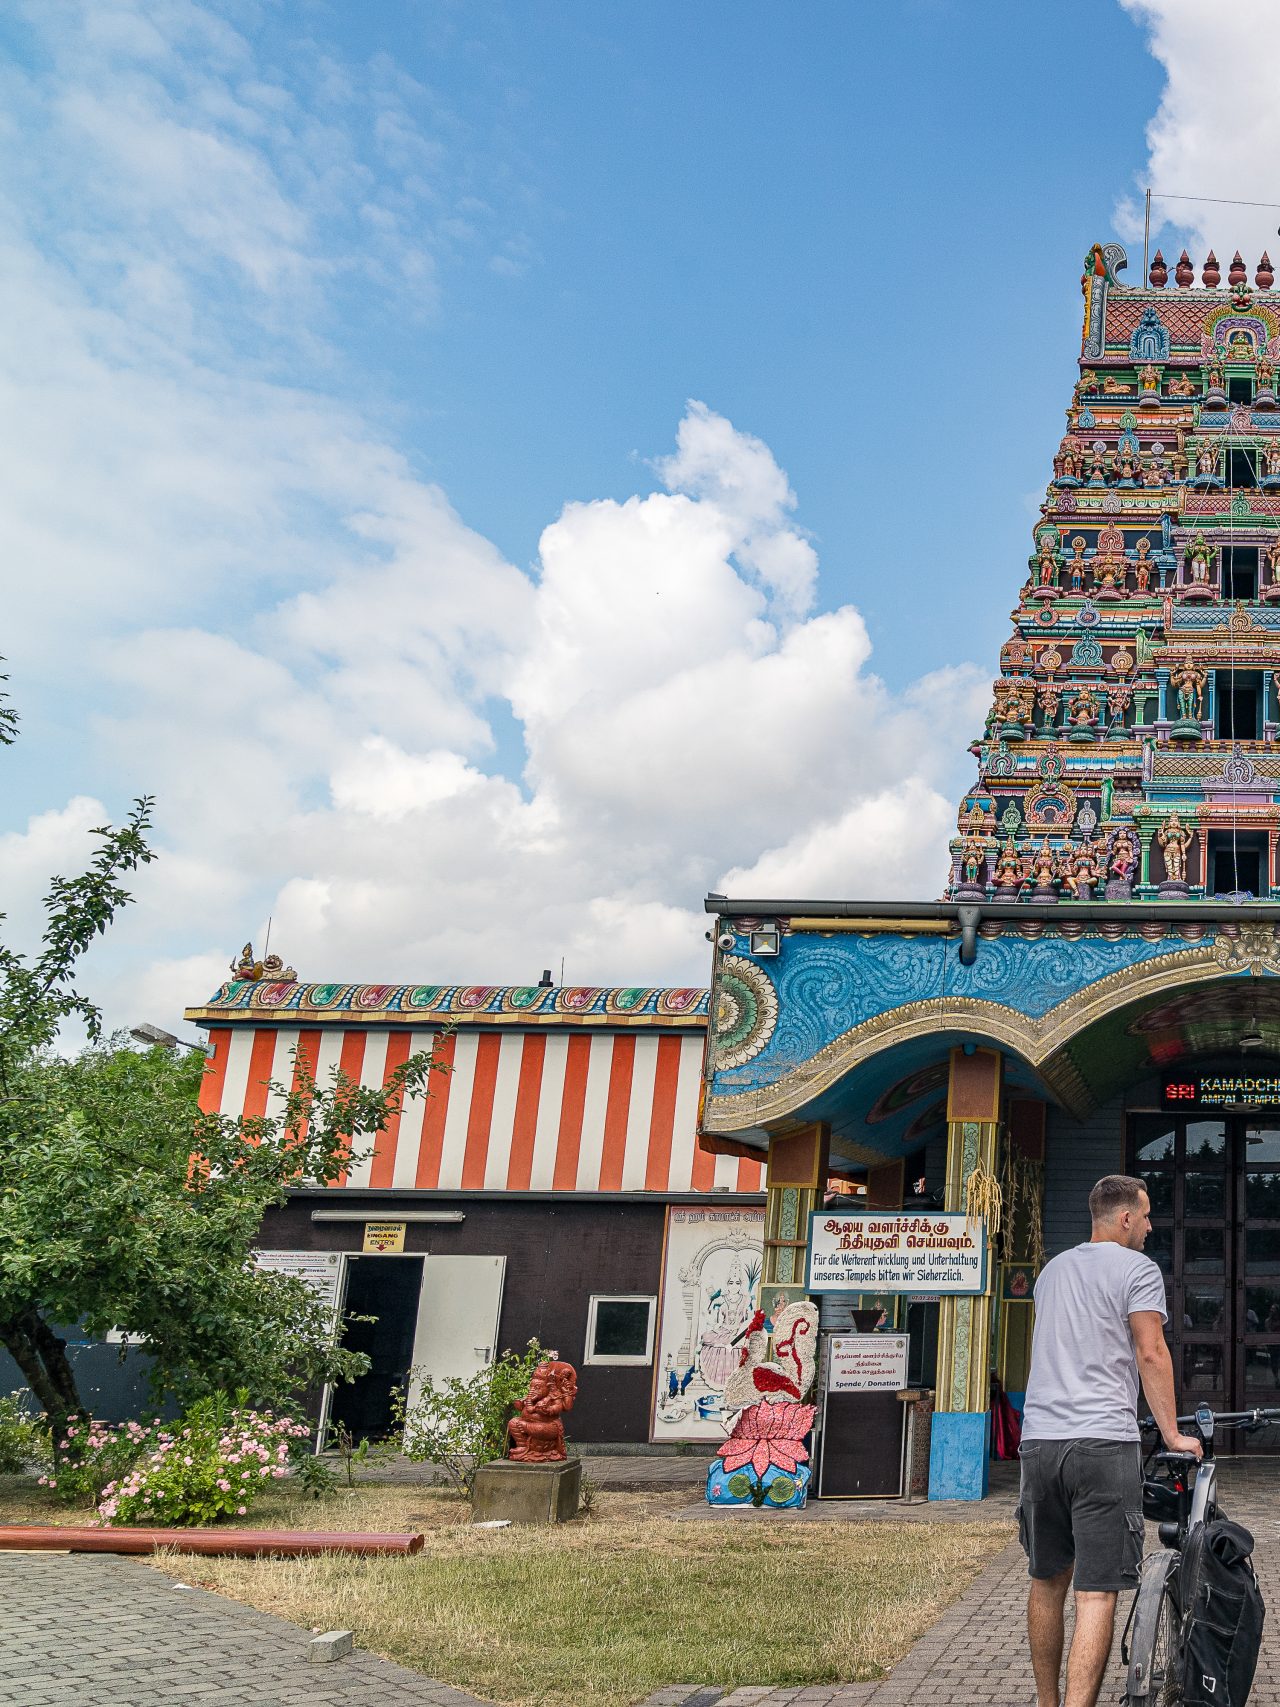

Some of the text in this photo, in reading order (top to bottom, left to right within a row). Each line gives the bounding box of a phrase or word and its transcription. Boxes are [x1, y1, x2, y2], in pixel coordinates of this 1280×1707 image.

[1165, 1084, 1195, 1099] SRI
[823, 1217, 949, 1235] ஆலய வளர்ச்சிக்கு
[836, 1231, 976, 1250] நிதியுதவி செய்யவும்.
[813, 1253, 827, 1266] Für
[828, 1253, 839, 1266] die
[911, 1253, 926, 1266] und
[928, 1253, 978, 1269] Unterhaltung
[814, 1271, 845, 1281] unseres
[845, 1269, 876, 1283] Tempels
[878, 1269, 900, 1281] bitten
[902, 1269, 915, 1281] wir
